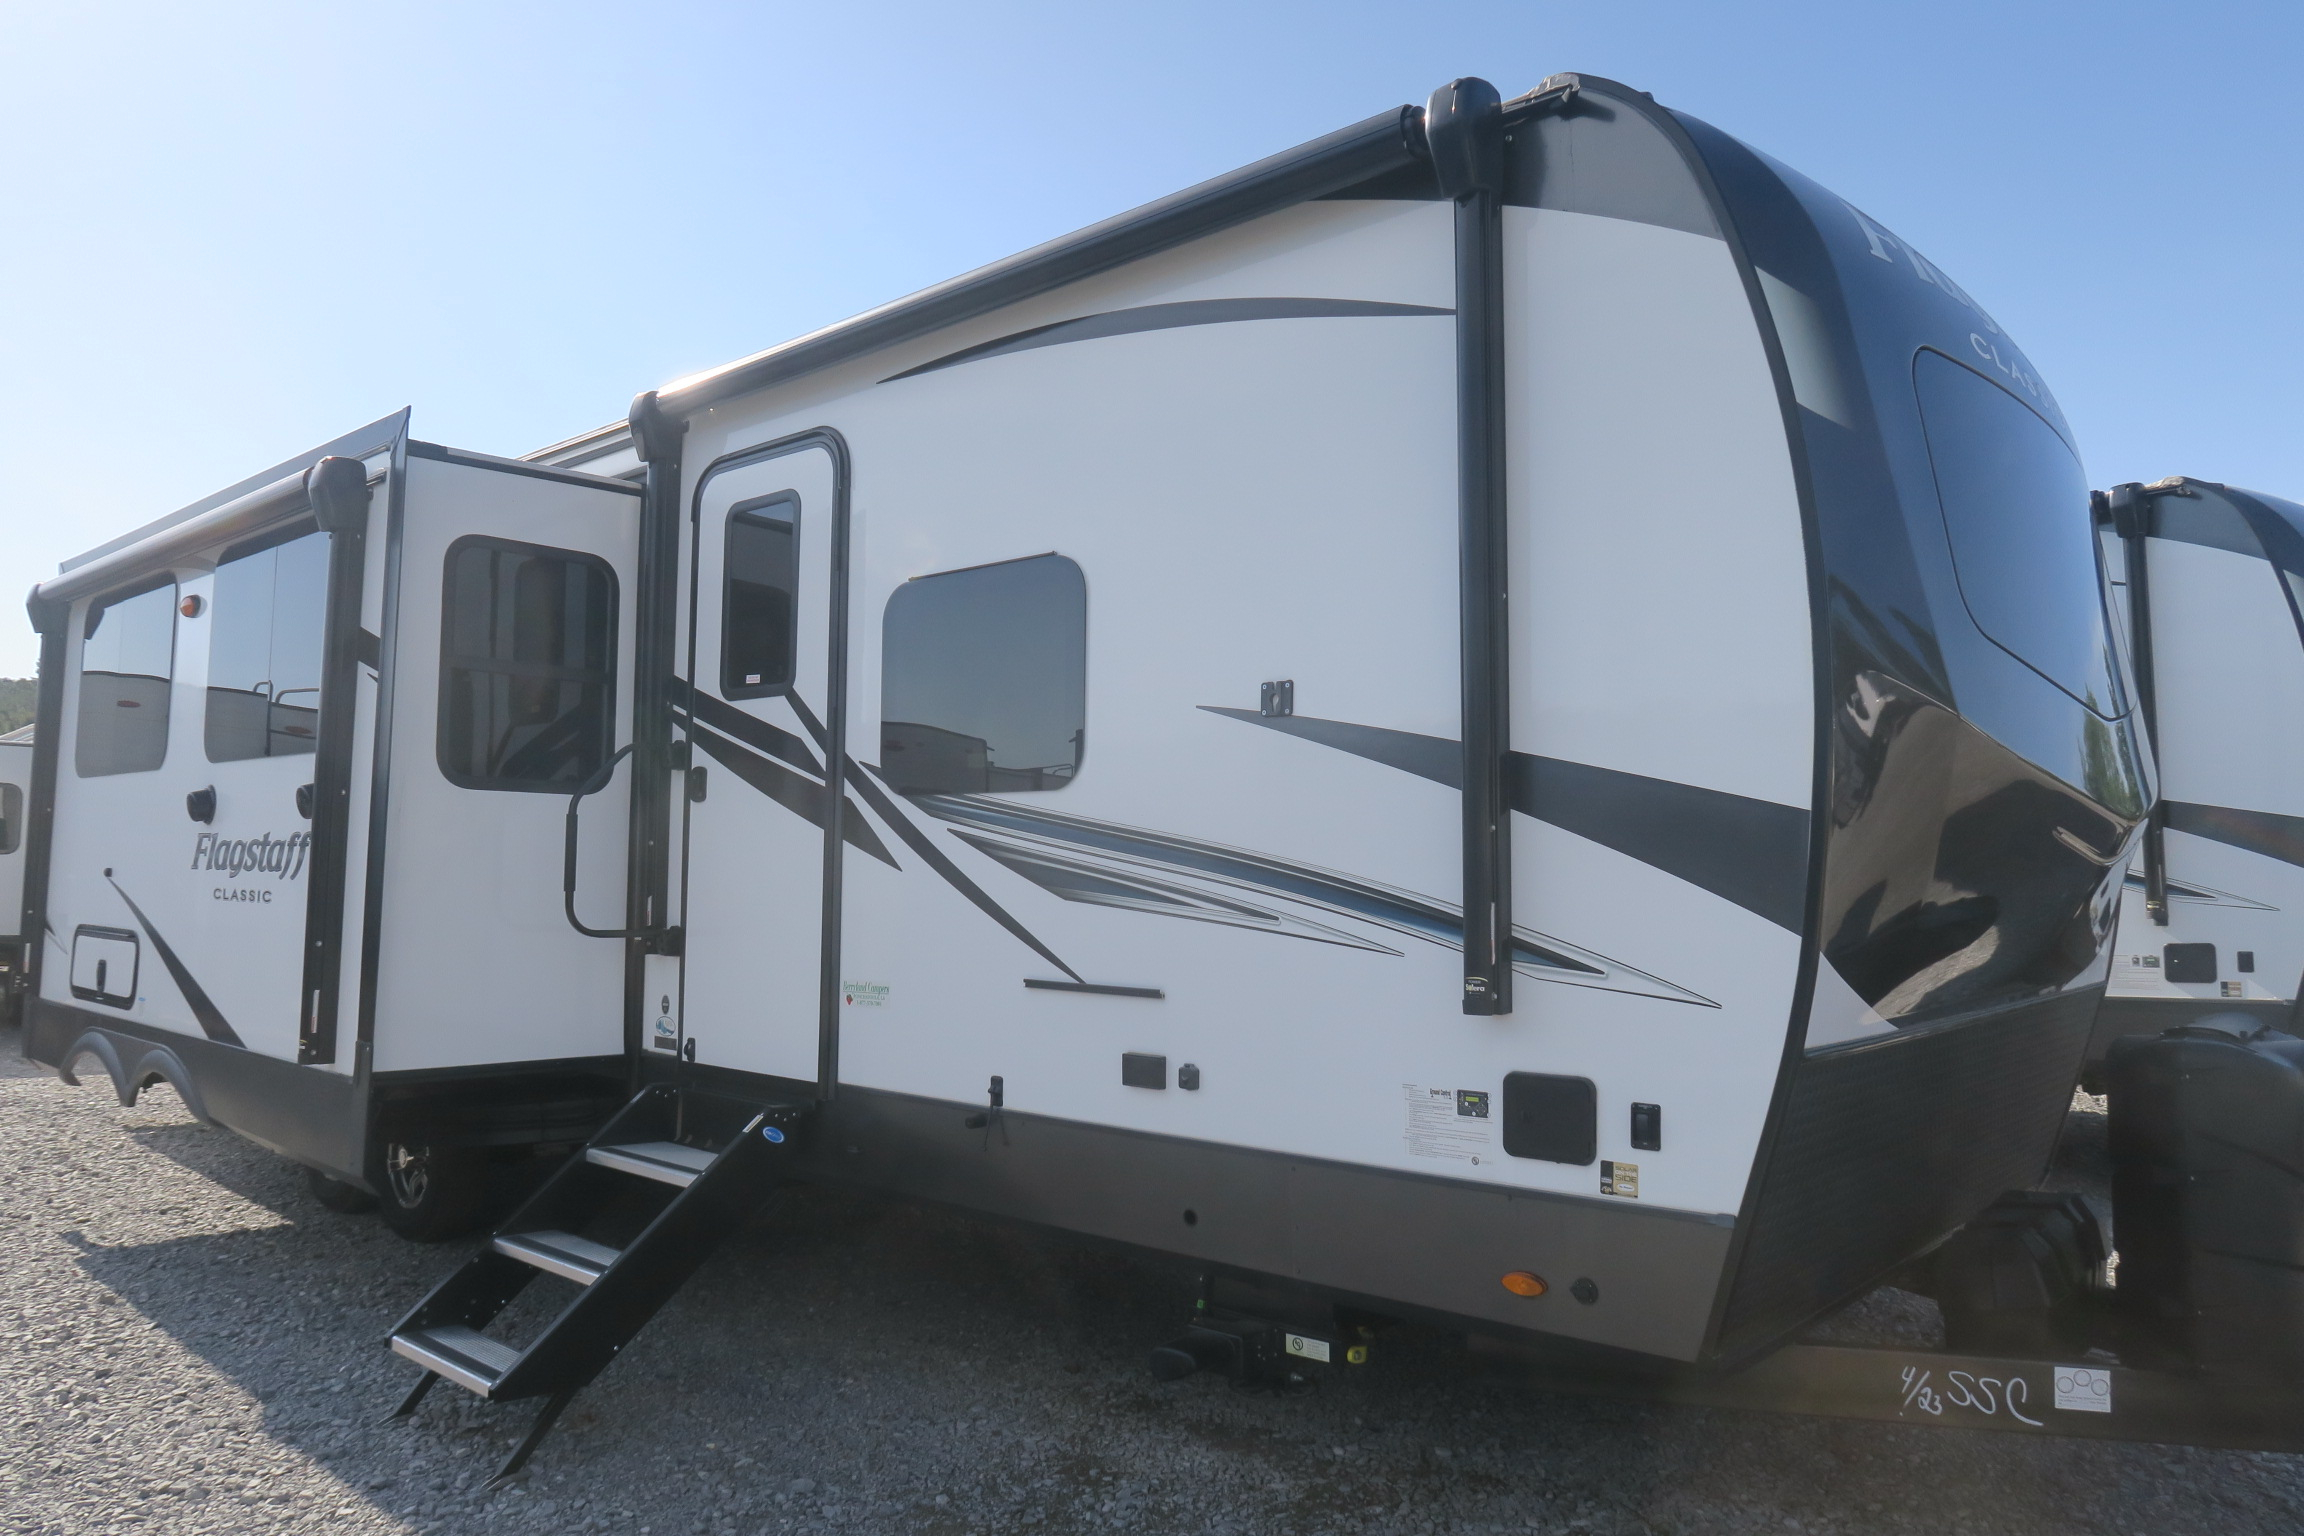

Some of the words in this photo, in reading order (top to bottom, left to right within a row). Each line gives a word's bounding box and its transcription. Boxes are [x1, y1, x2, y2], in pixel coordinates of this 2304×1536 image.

[191, 831, 311, 880] Flagstaff
[213, 888, 272, 903] CLASSIC
[1465, 983, 1485, 991] Solera
[1615, 1174, 1638, 1183] SIDE
